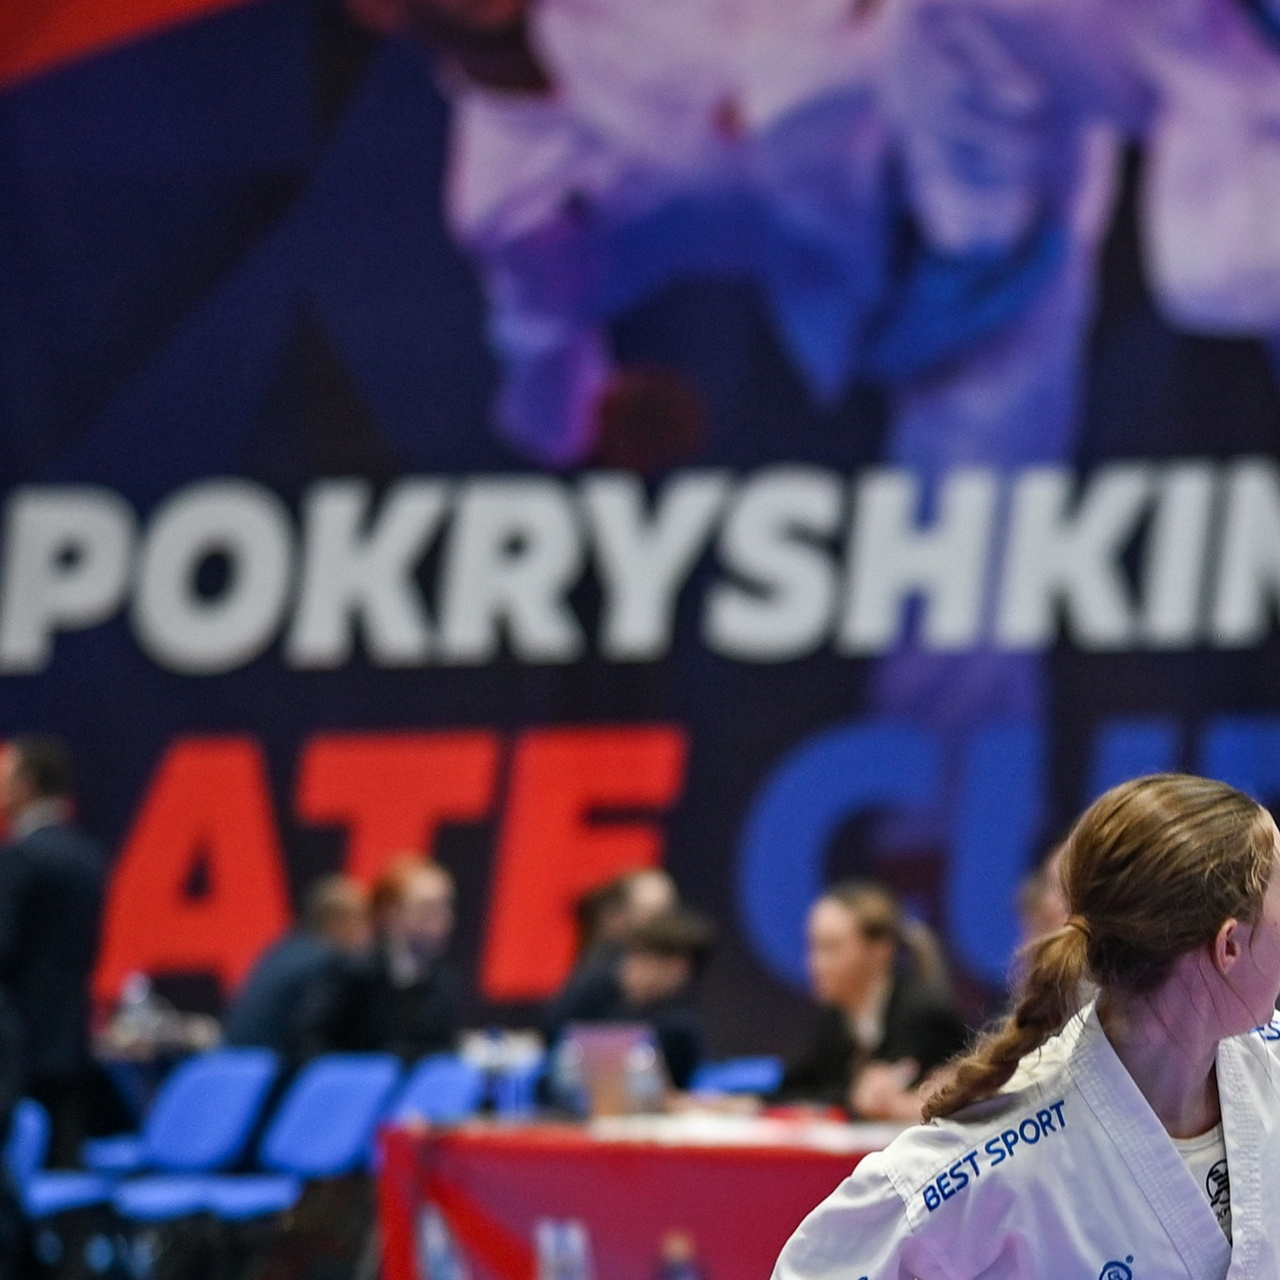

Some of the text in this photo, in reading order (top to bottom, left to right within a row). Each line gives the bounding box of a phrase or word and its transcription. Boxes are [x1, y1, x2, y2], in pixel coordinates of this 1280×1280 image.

[0, 722, 690, 1035] ATE
[922, 1099, 1066, 1212] BEST SPORT
